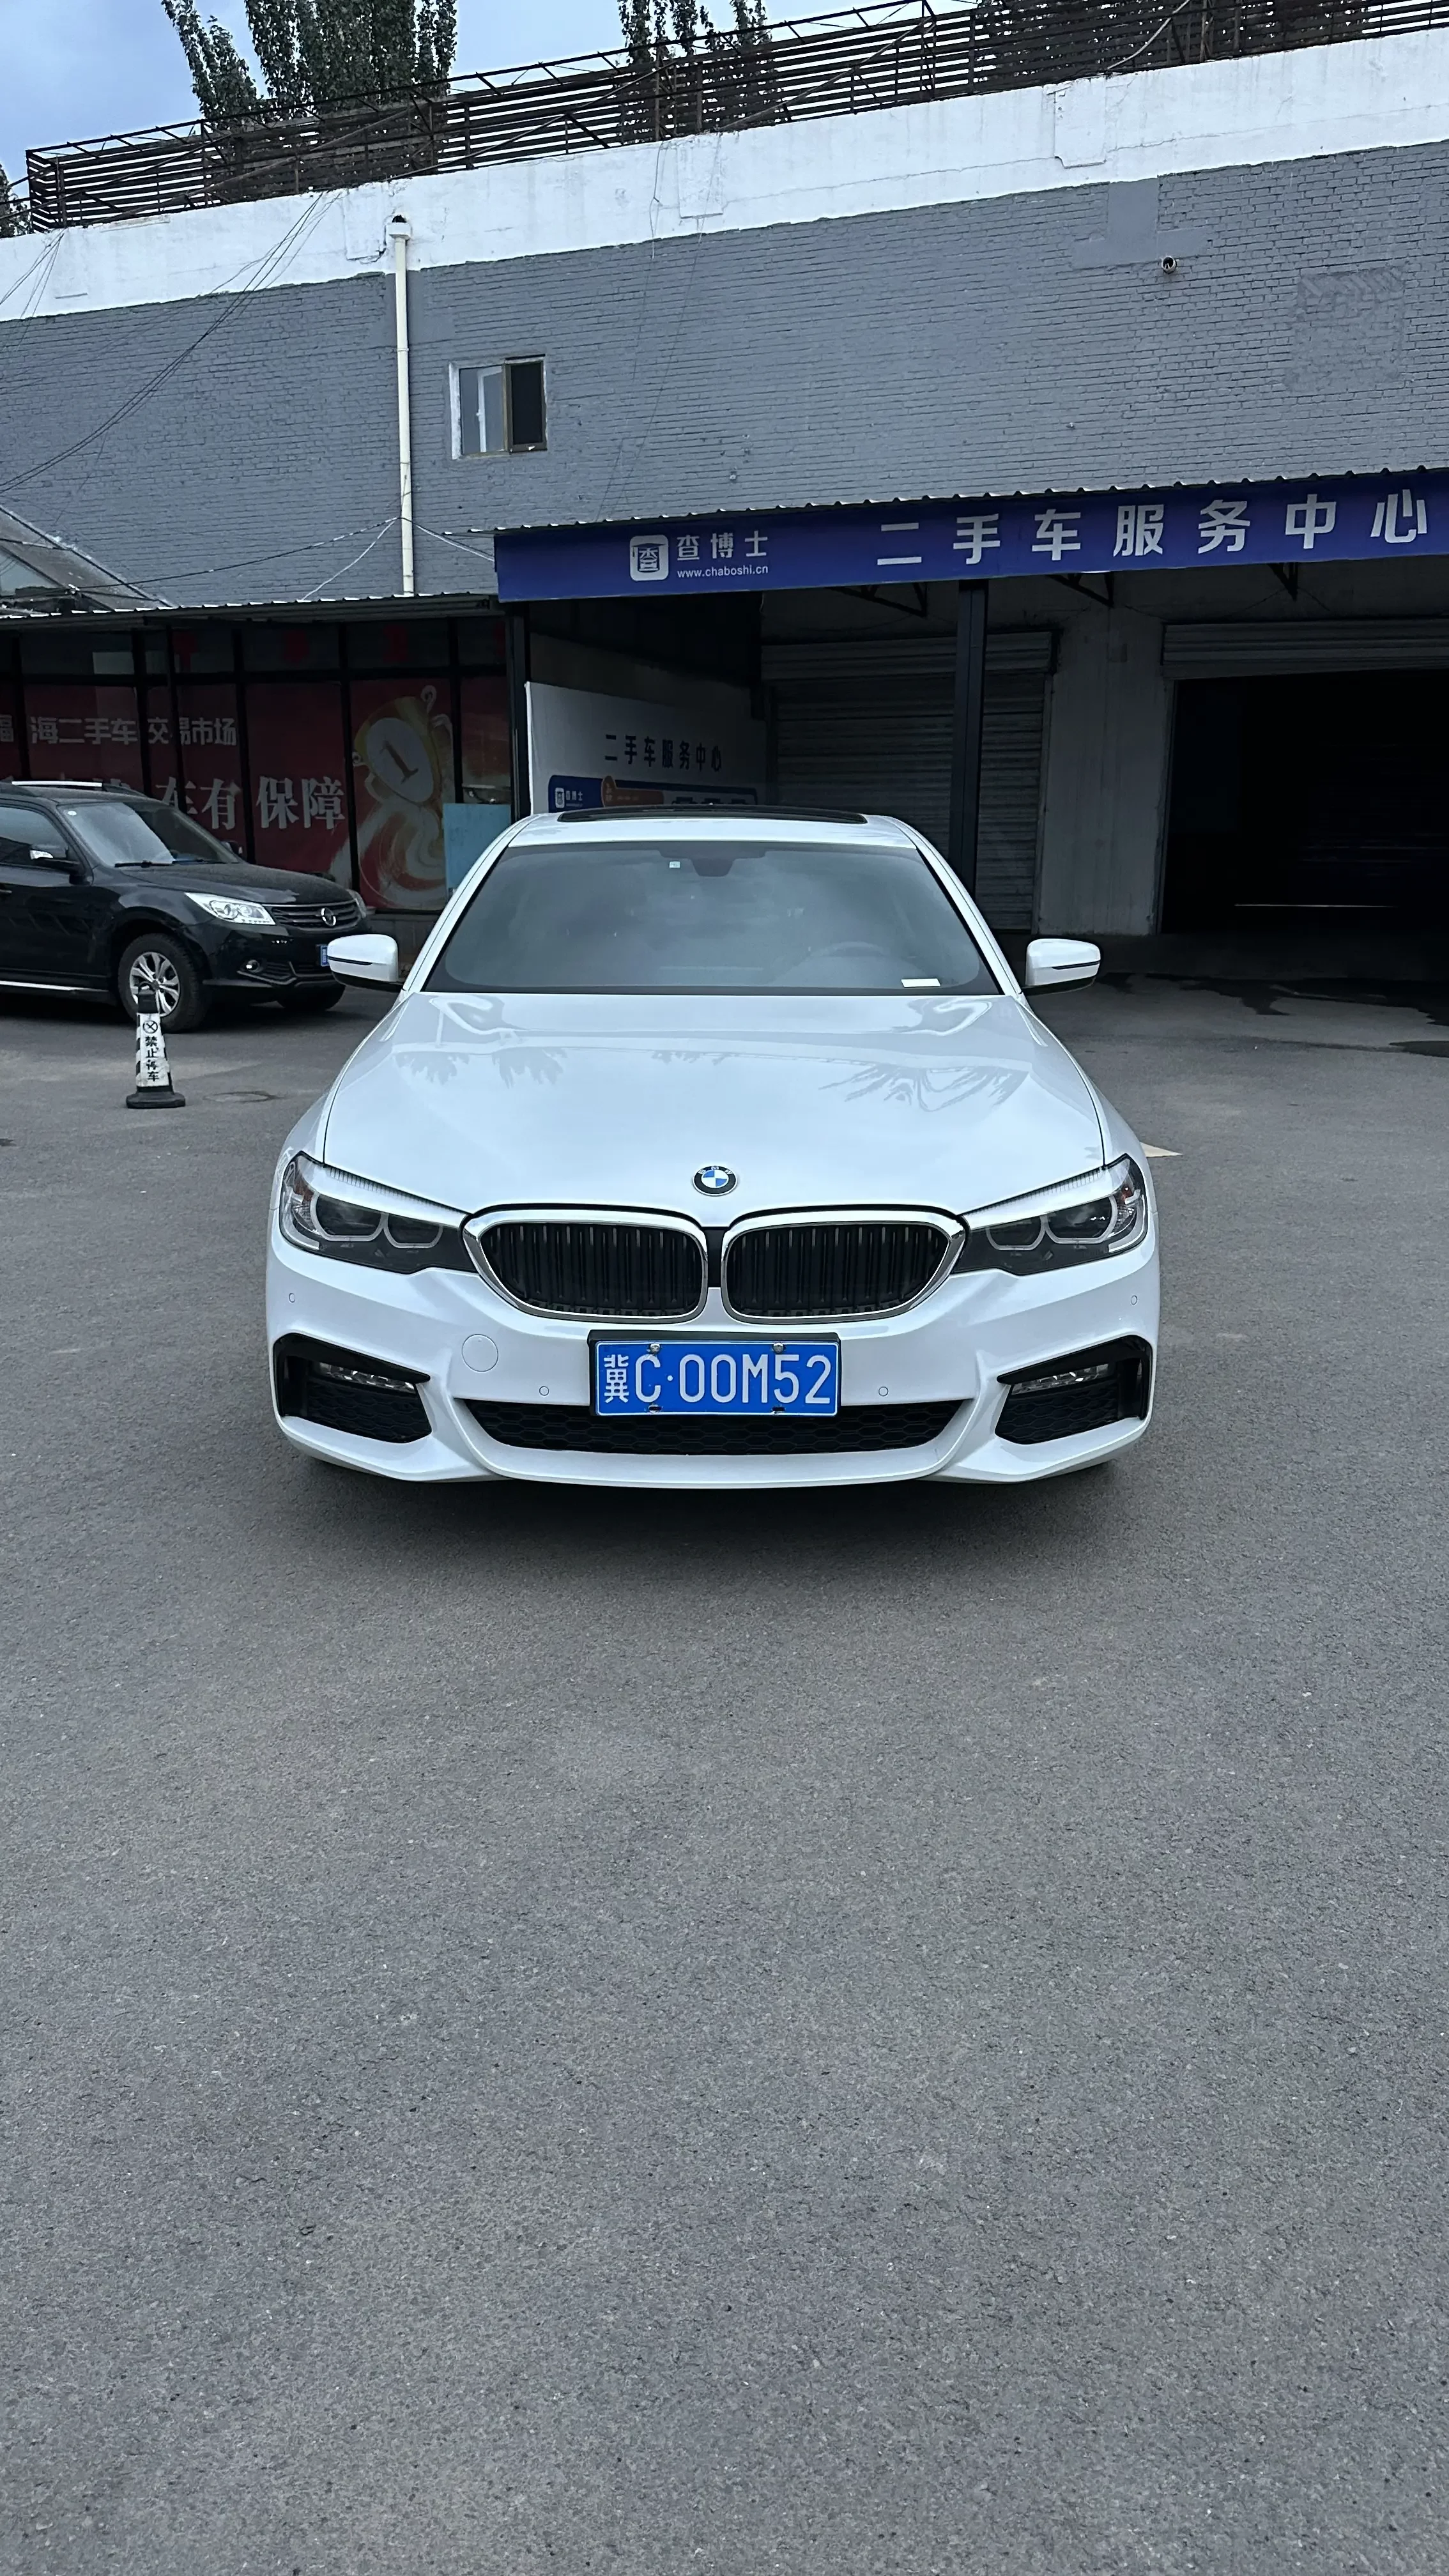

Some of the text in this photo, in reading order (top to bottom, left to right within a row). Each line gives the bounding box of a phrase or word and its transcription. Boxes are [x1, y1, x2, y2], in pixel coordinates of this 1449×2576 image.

[677, 530, 768, 561] 查博士
[877, 489, 1427, 566] 二手车服务中心
[677, 565, 768, 578] www.chaboshi.cn
[605, 734, 722, 772] 二手车服务中心
[145, 1036, 160, 1081] 禁止停车
[698, 1166, 733, 1174] BMW
[603, 1354, 831, 1404] 冀C·00M52
